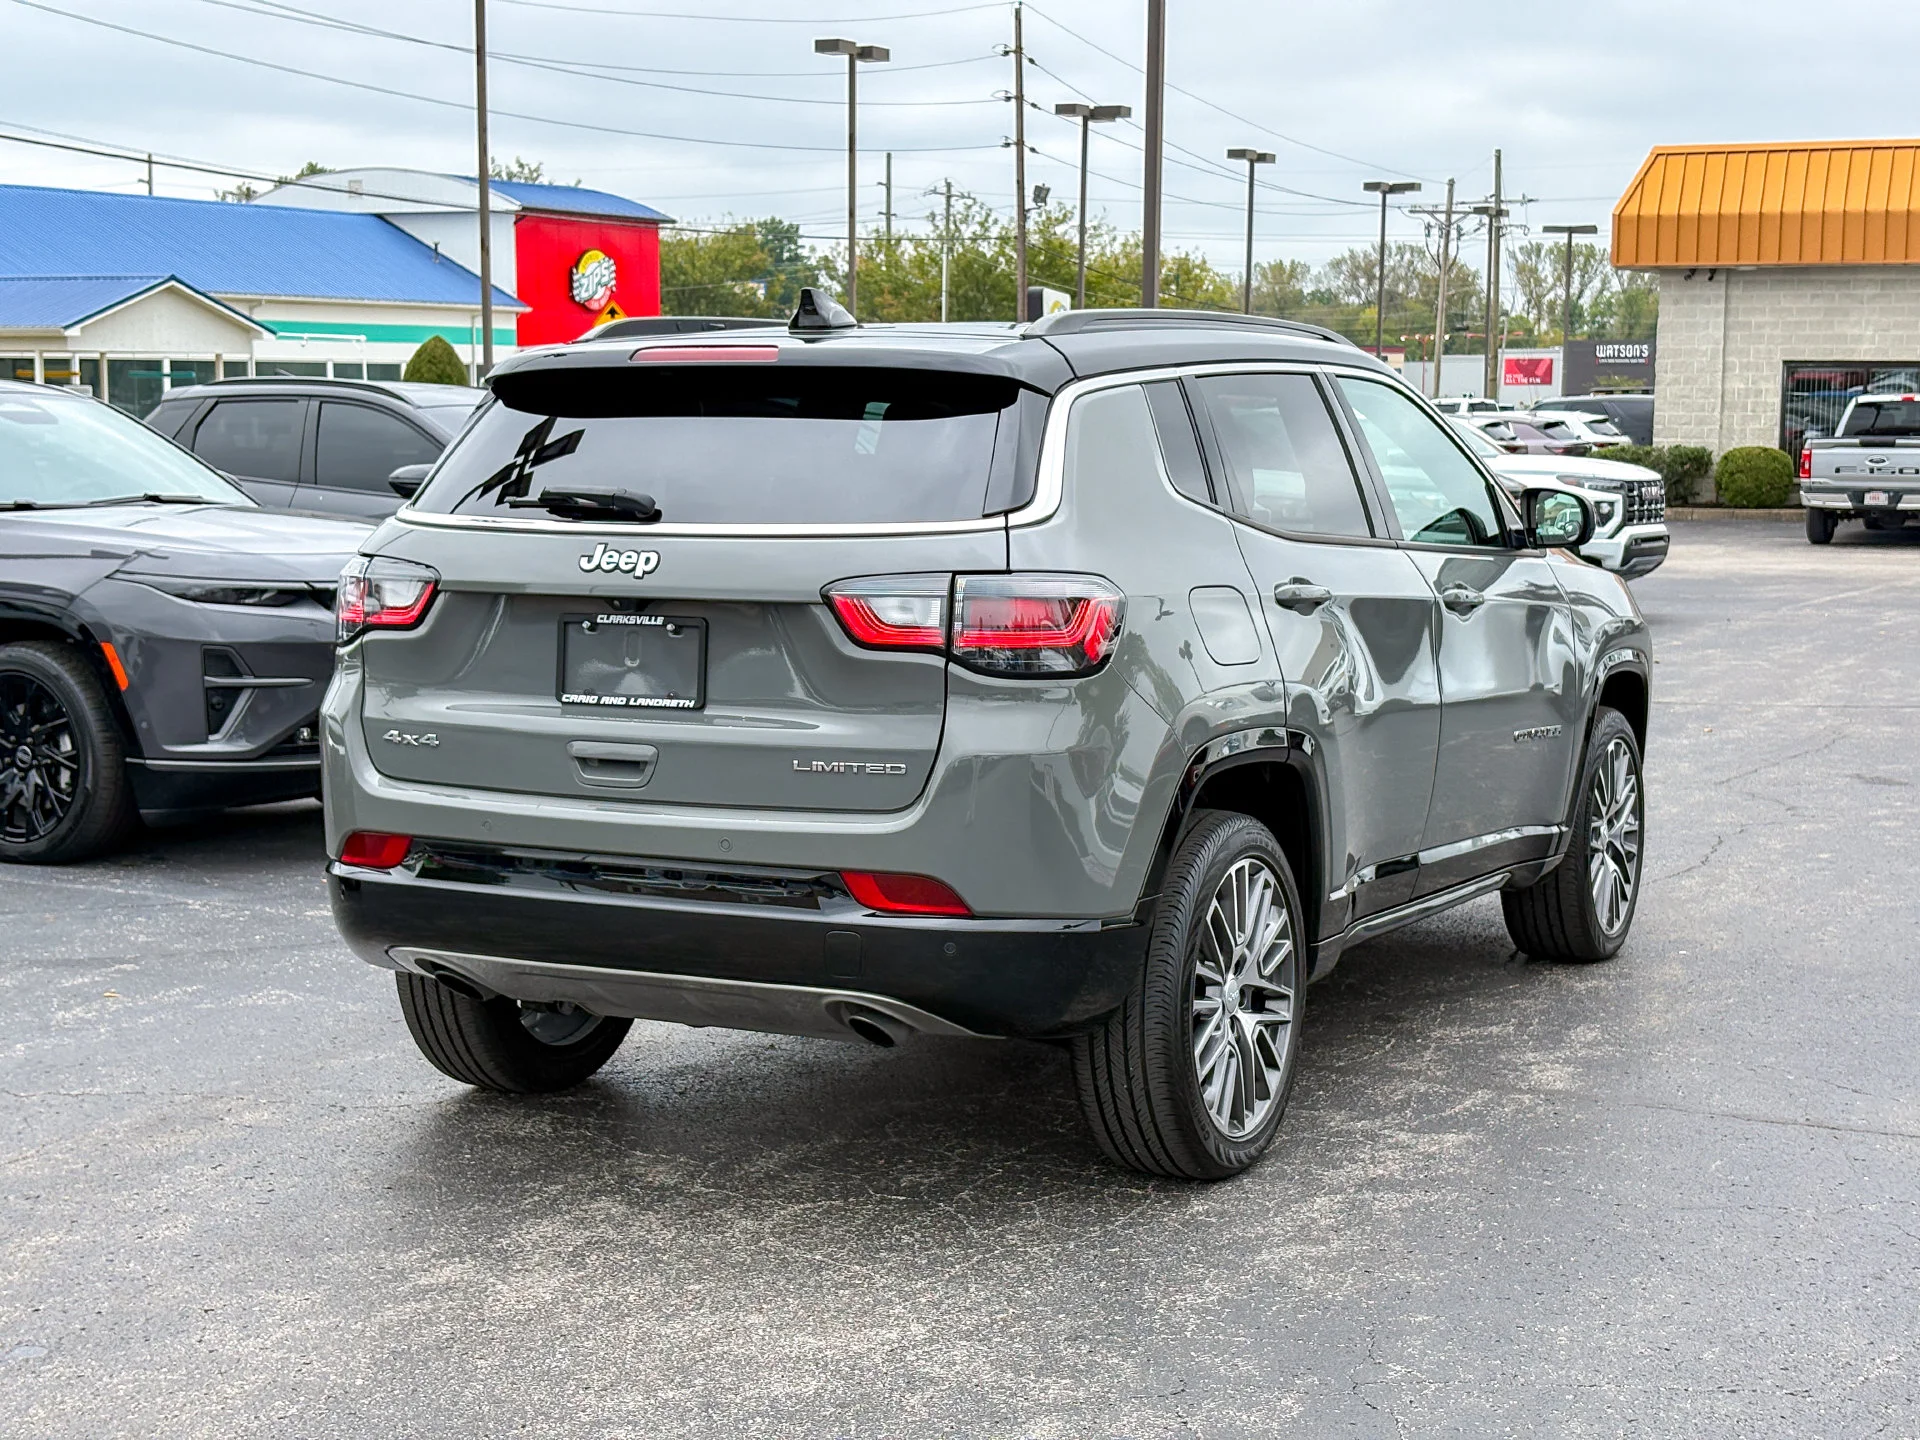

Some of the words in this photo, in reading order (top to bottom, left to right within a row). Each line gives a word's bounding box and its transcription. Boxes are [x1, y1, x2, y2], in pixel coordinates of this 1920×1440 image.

[579, 260, 610, 299] ZIPS
[1595, 344, 1649, 358] WATSON'S
[579, 543, 661, 579] Jeep
[596, 614, 665, 625] CLARKSVILLE
[561, 694, 598, 704] CRAIG
[599, 696, 627, 705] AND
[628, 698, 696, 709] LANDRETH
[382, 729, 440, 747] 4x4
[792, 759, 907, 775] LIMITED
